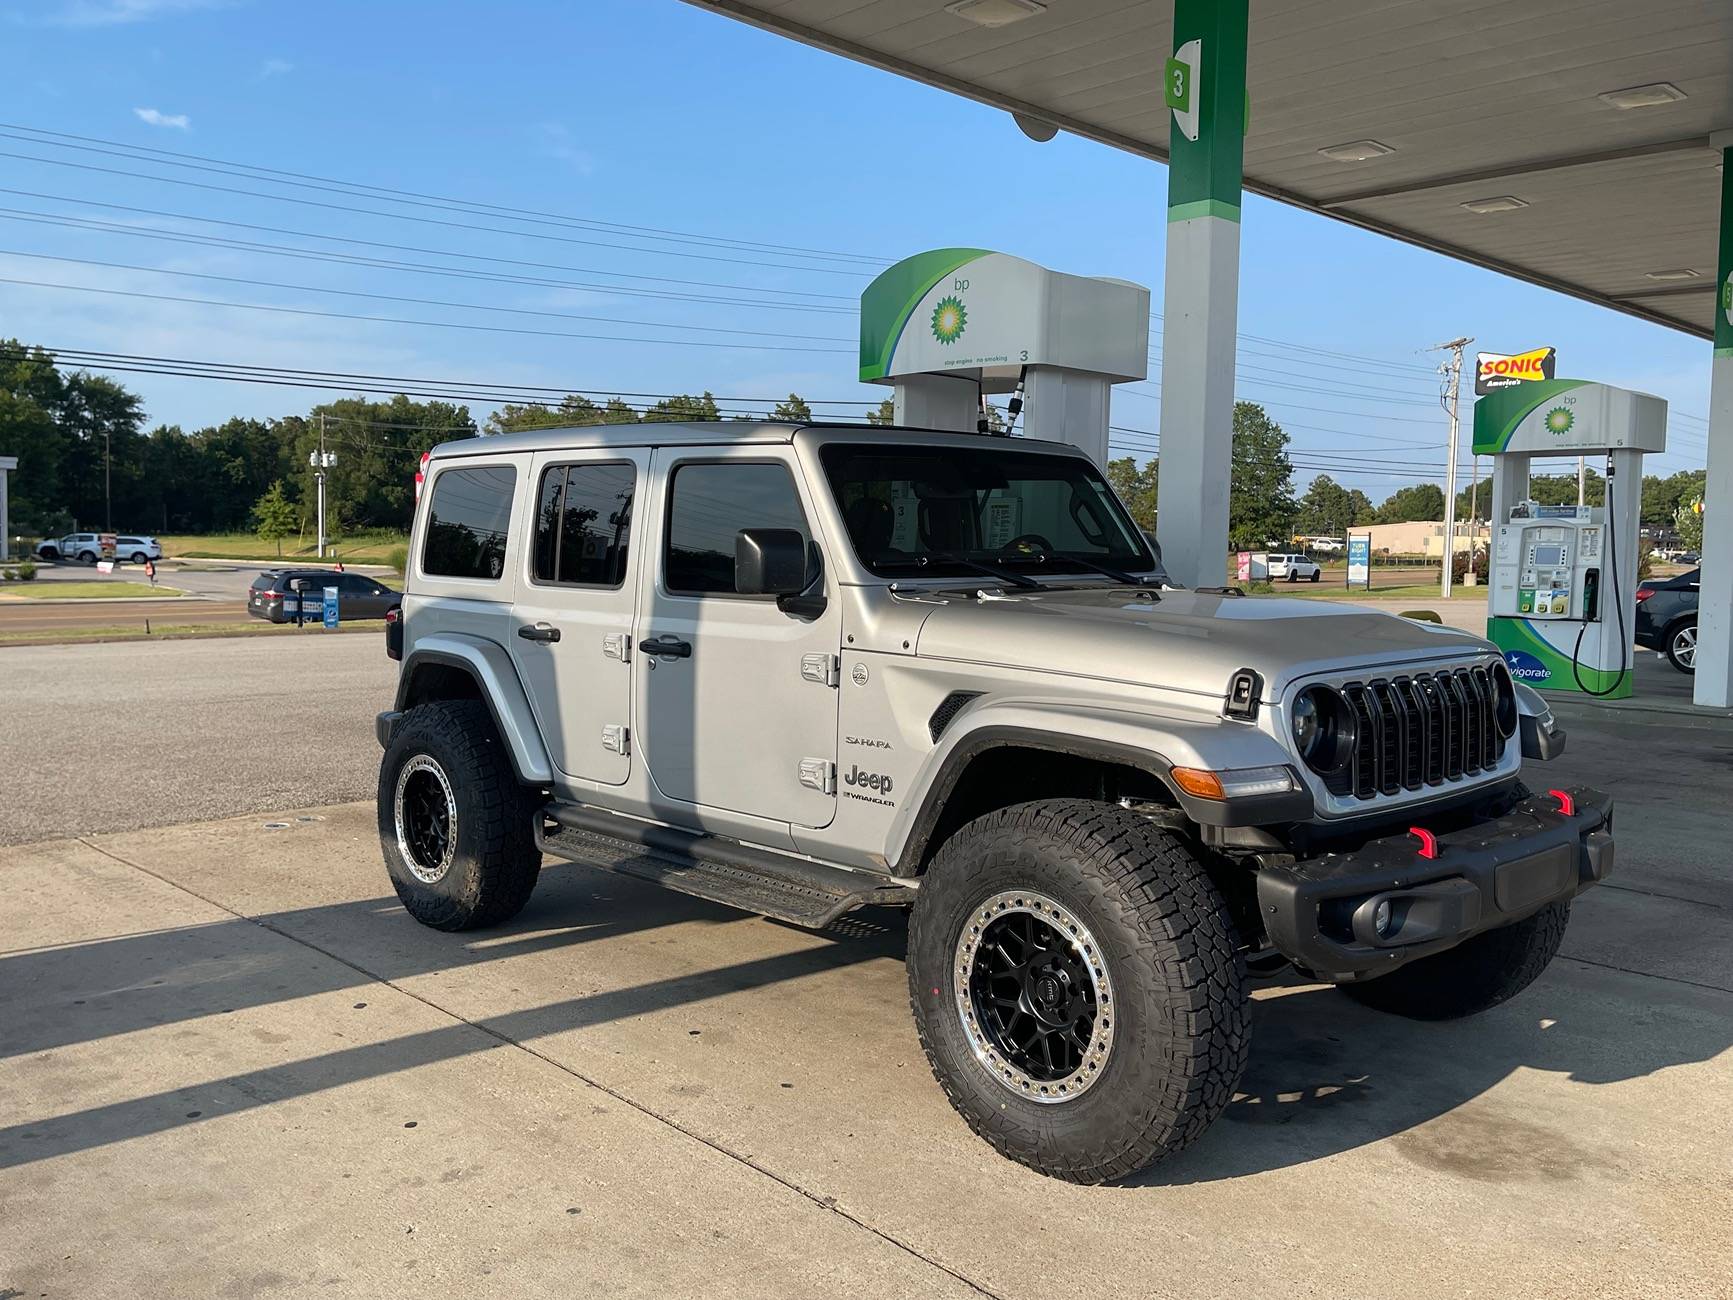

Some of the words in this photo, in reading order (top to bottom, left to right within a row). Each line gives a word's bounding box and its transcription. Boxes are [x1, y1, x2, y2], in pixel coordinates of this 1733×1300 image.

[1173, 69, 1184, 98] 3
[954, 278, 970, 293] bp
[984, 354, 1008, 362] smoking
[1020, 350, 1028, 361] 3
[1483, 358, 1543, 375] SONIC
[1486, 379, 1521, 387] America's
[1563, 396, 1577, 405] bp
[1616, 438, 1624, 447] 5
[897, 506, 905, 517] 3
[1510, 666, 1552, 678] vigorate
[845, 737, 893, 749] SAHARA
[844, 765, 893, 795] Jeep
[851, 793, 895, 807] WRANGLER
